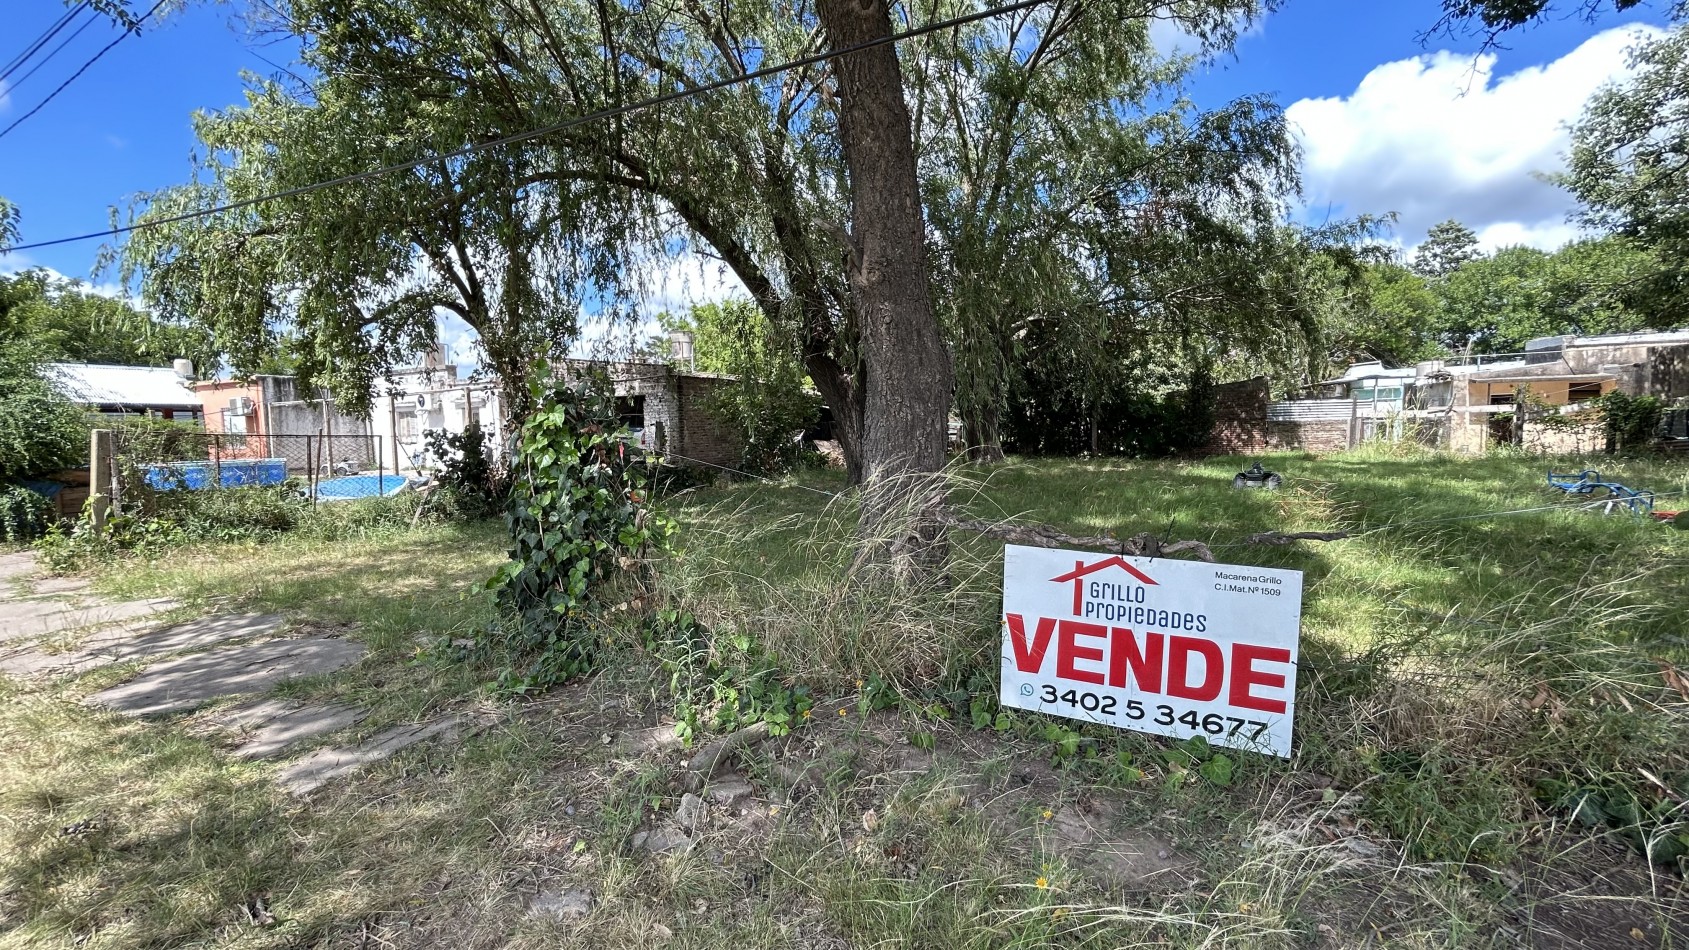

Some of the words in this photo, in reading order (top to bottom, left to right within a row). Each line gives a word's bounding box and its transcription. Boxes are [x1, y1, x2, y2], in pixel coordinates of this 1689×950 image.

[1215, 571, 1257, 582] Macarena
[1258, 575, 1282, 585] Grillo
[1261, 587, 1281, 596] 1509
[1005, 612, 1291, 715] VENDE
[1039, 684, 1117, 716] 3402
[1125, 699, 1146, 720] 5
[1153, 704, 1268, 743] 34677
